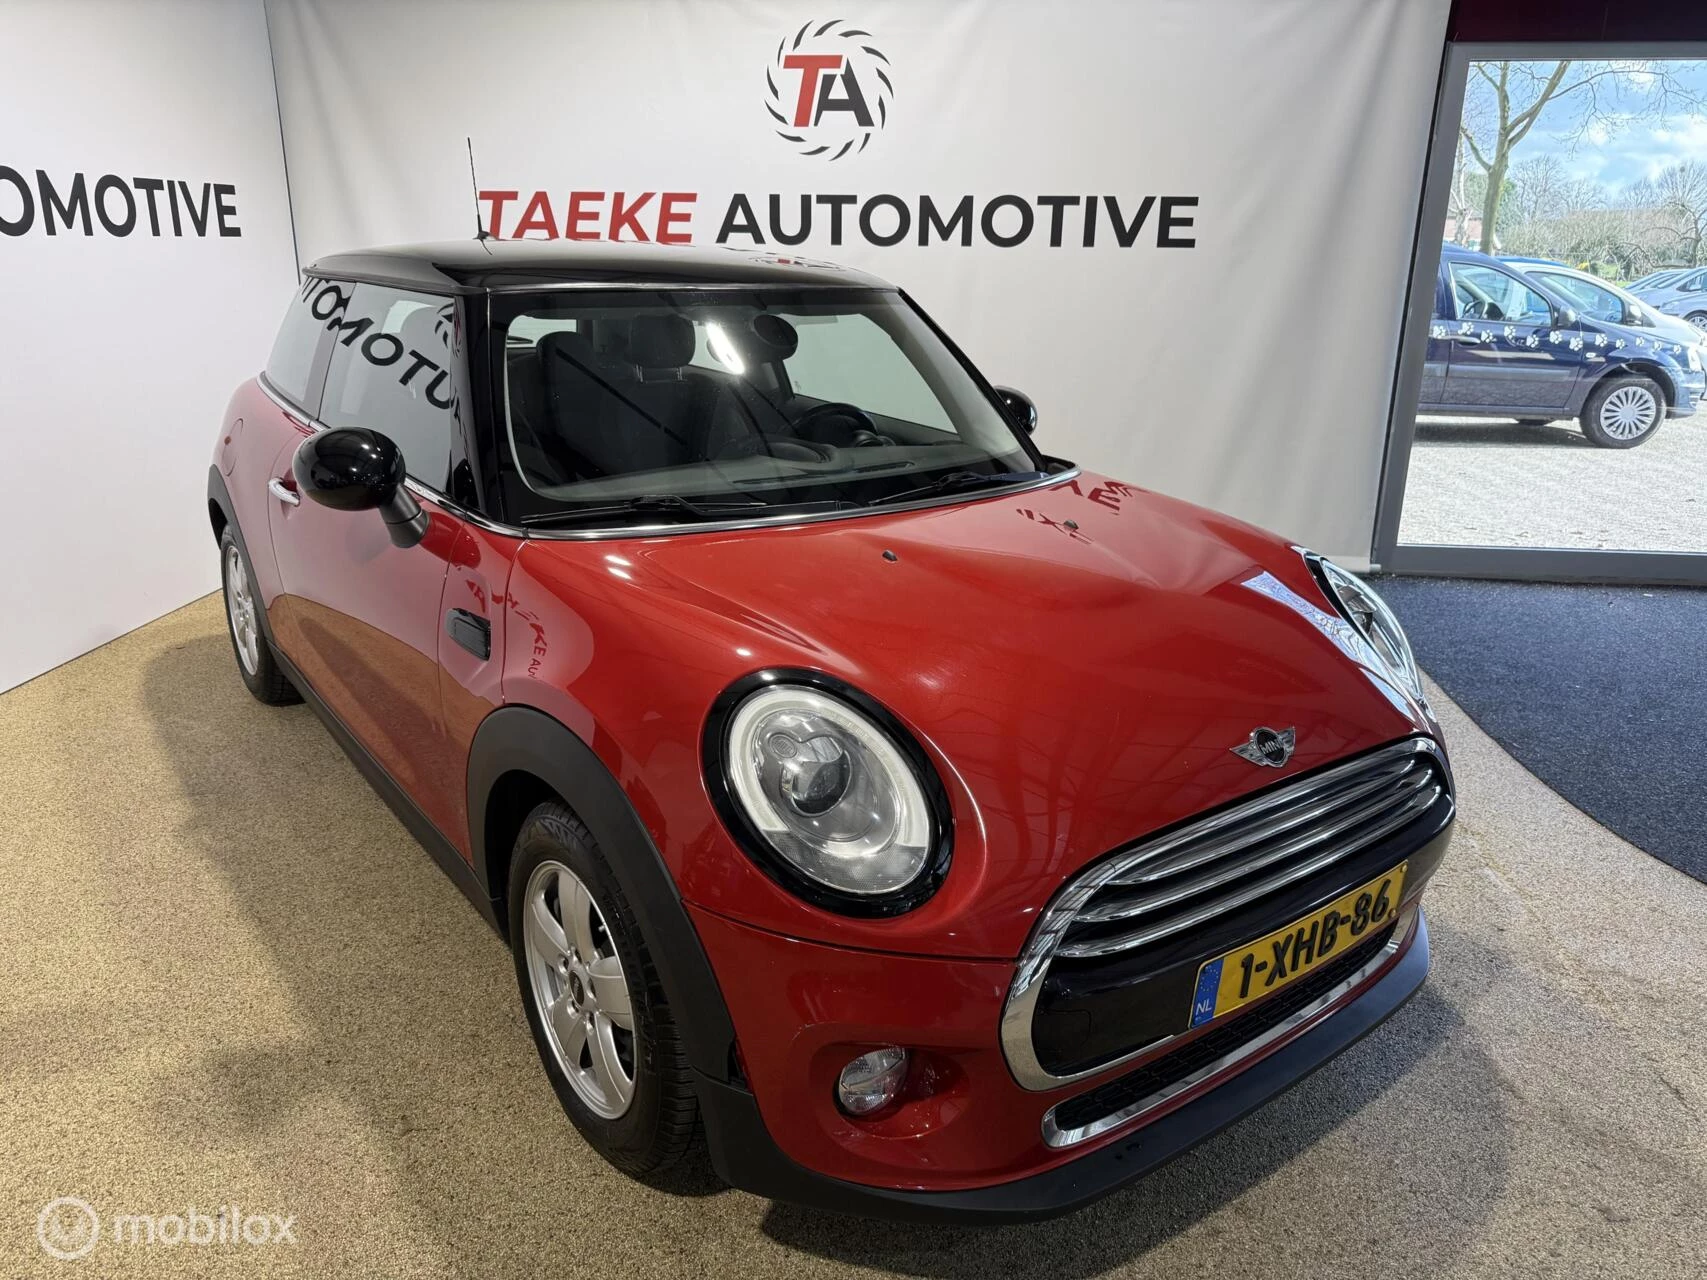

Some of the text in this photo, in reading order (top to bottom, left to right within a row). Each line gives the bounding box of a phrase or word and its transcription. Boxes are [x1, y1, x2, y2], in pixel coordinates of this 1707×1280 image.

[783, 55, 875, 127] TA
[479, 190, 1199, 248] TAEKE AUTOMOTIVE
[1239, 878, 1392, 999] 1-XHB-86
[1195, 999, 1212, 1015] NL
